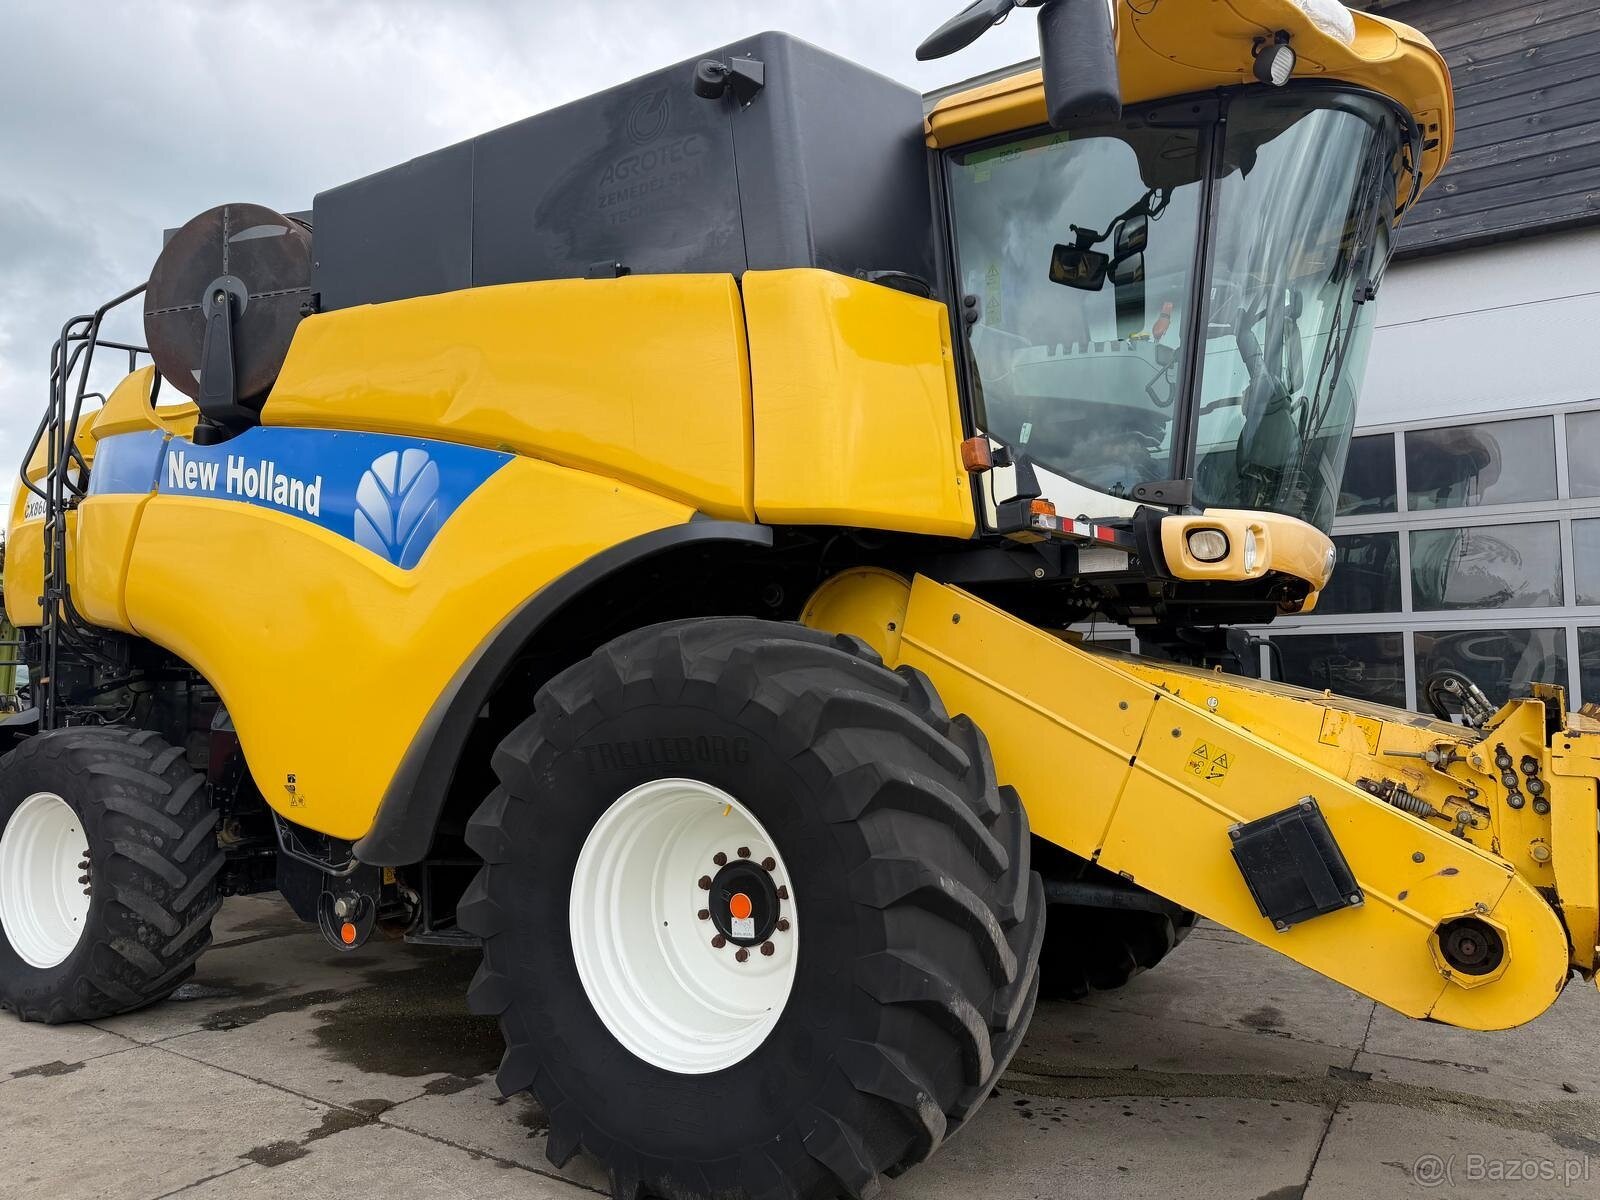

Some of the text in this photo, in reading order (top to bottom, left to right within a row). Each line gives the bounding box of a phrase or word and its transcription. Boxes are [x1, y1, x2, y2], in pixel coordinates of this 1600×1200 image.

[599, 135, 702, 186] AGROTEC
[168, 451, 322, 517] New Holland
[583, 735, 751, 774] TRELLEBORG
